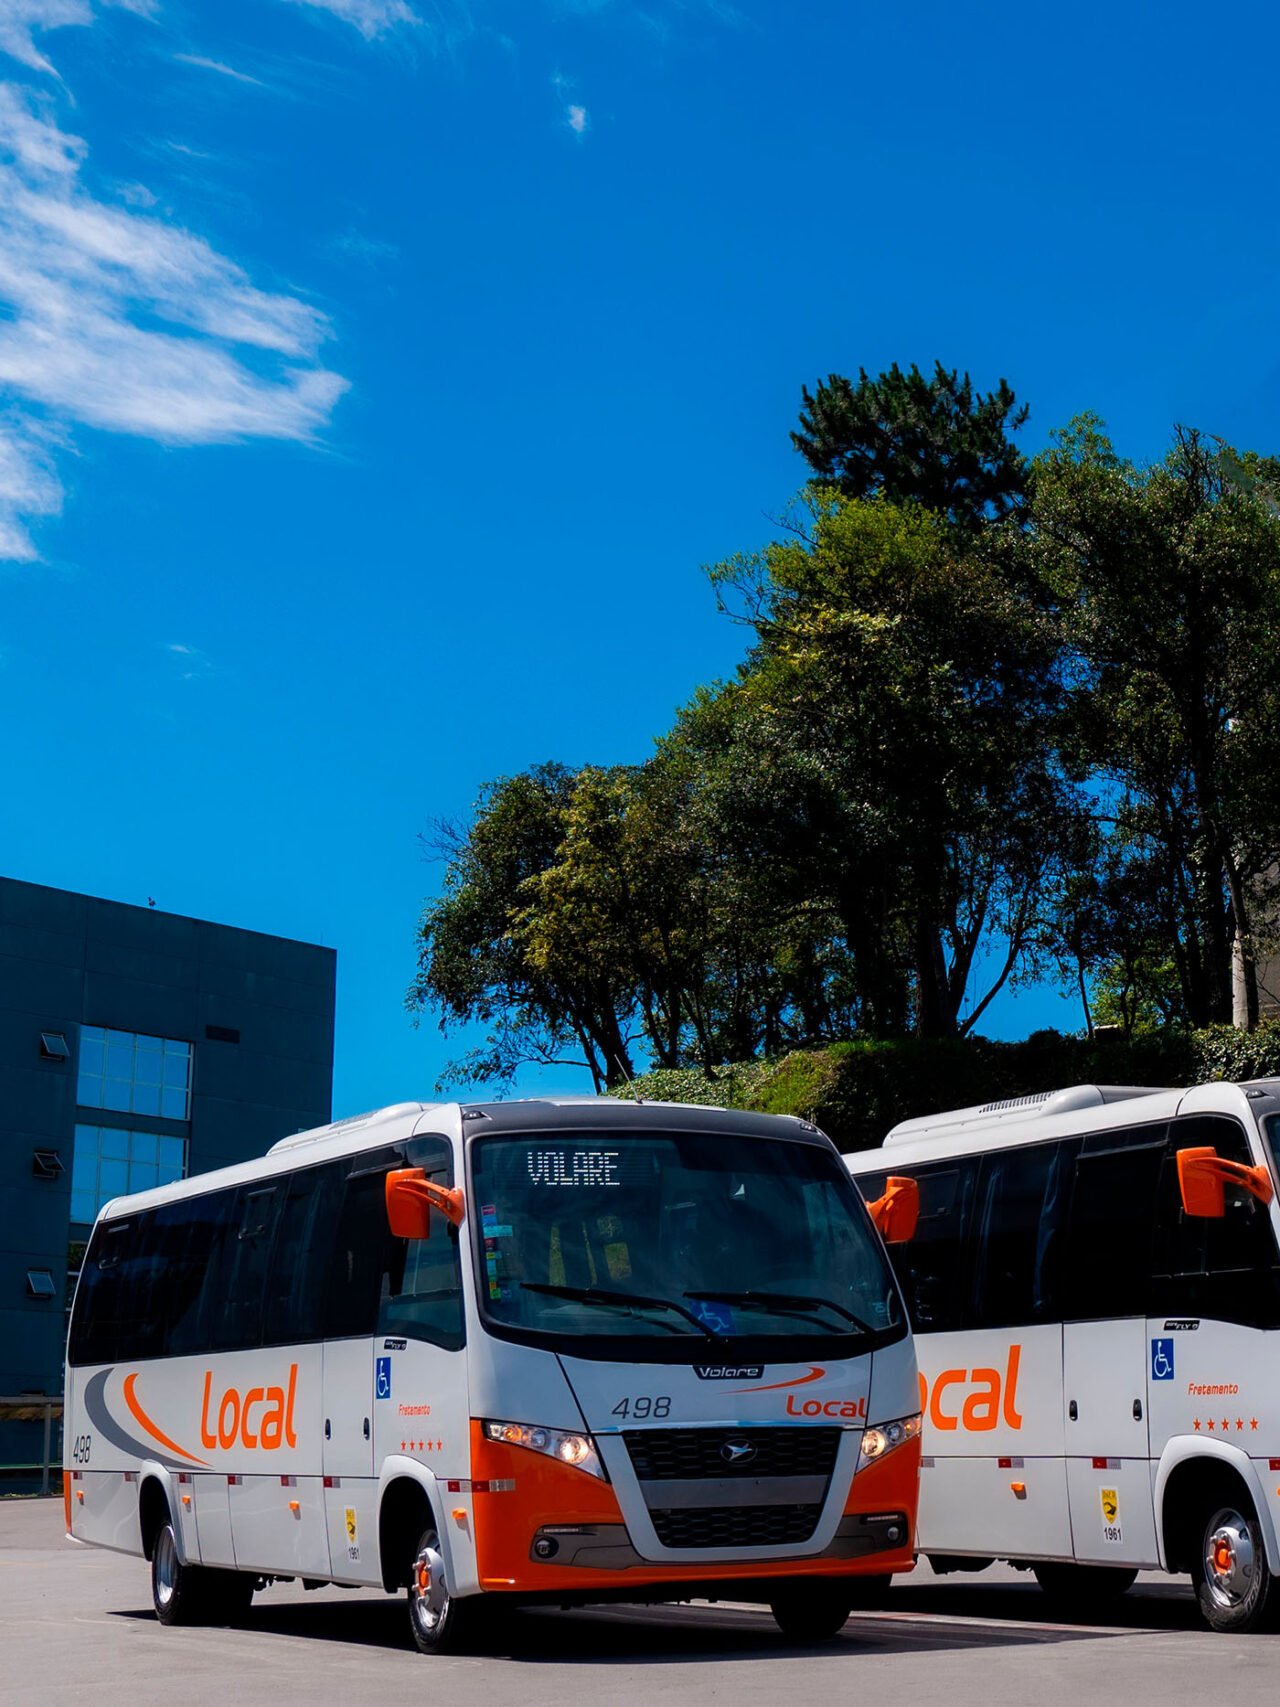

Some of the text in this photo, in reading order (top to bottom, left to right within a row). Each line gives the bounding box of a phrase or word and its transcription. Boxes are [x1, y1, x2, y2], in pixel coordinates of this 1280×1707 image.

[527, 1151, 621, 1186] VOLARE
[699, 1365, 760, 1380] Volare
[920, 1344, 1022, 1432] cal
[1188, 1383, 1239, 1395] Fretamento
[201, 1363, 298, 1450] Local
[398, 1404, 431, 1416] Fretamento
[611, 1396, 672, 1420] 498
[786, 1395, 867, 1419] Local
[73, 1434, 92, 1464] 498
[1104, 1527, 1122, 1541] 1961
[348, 1546, 360, 1561] 1961
